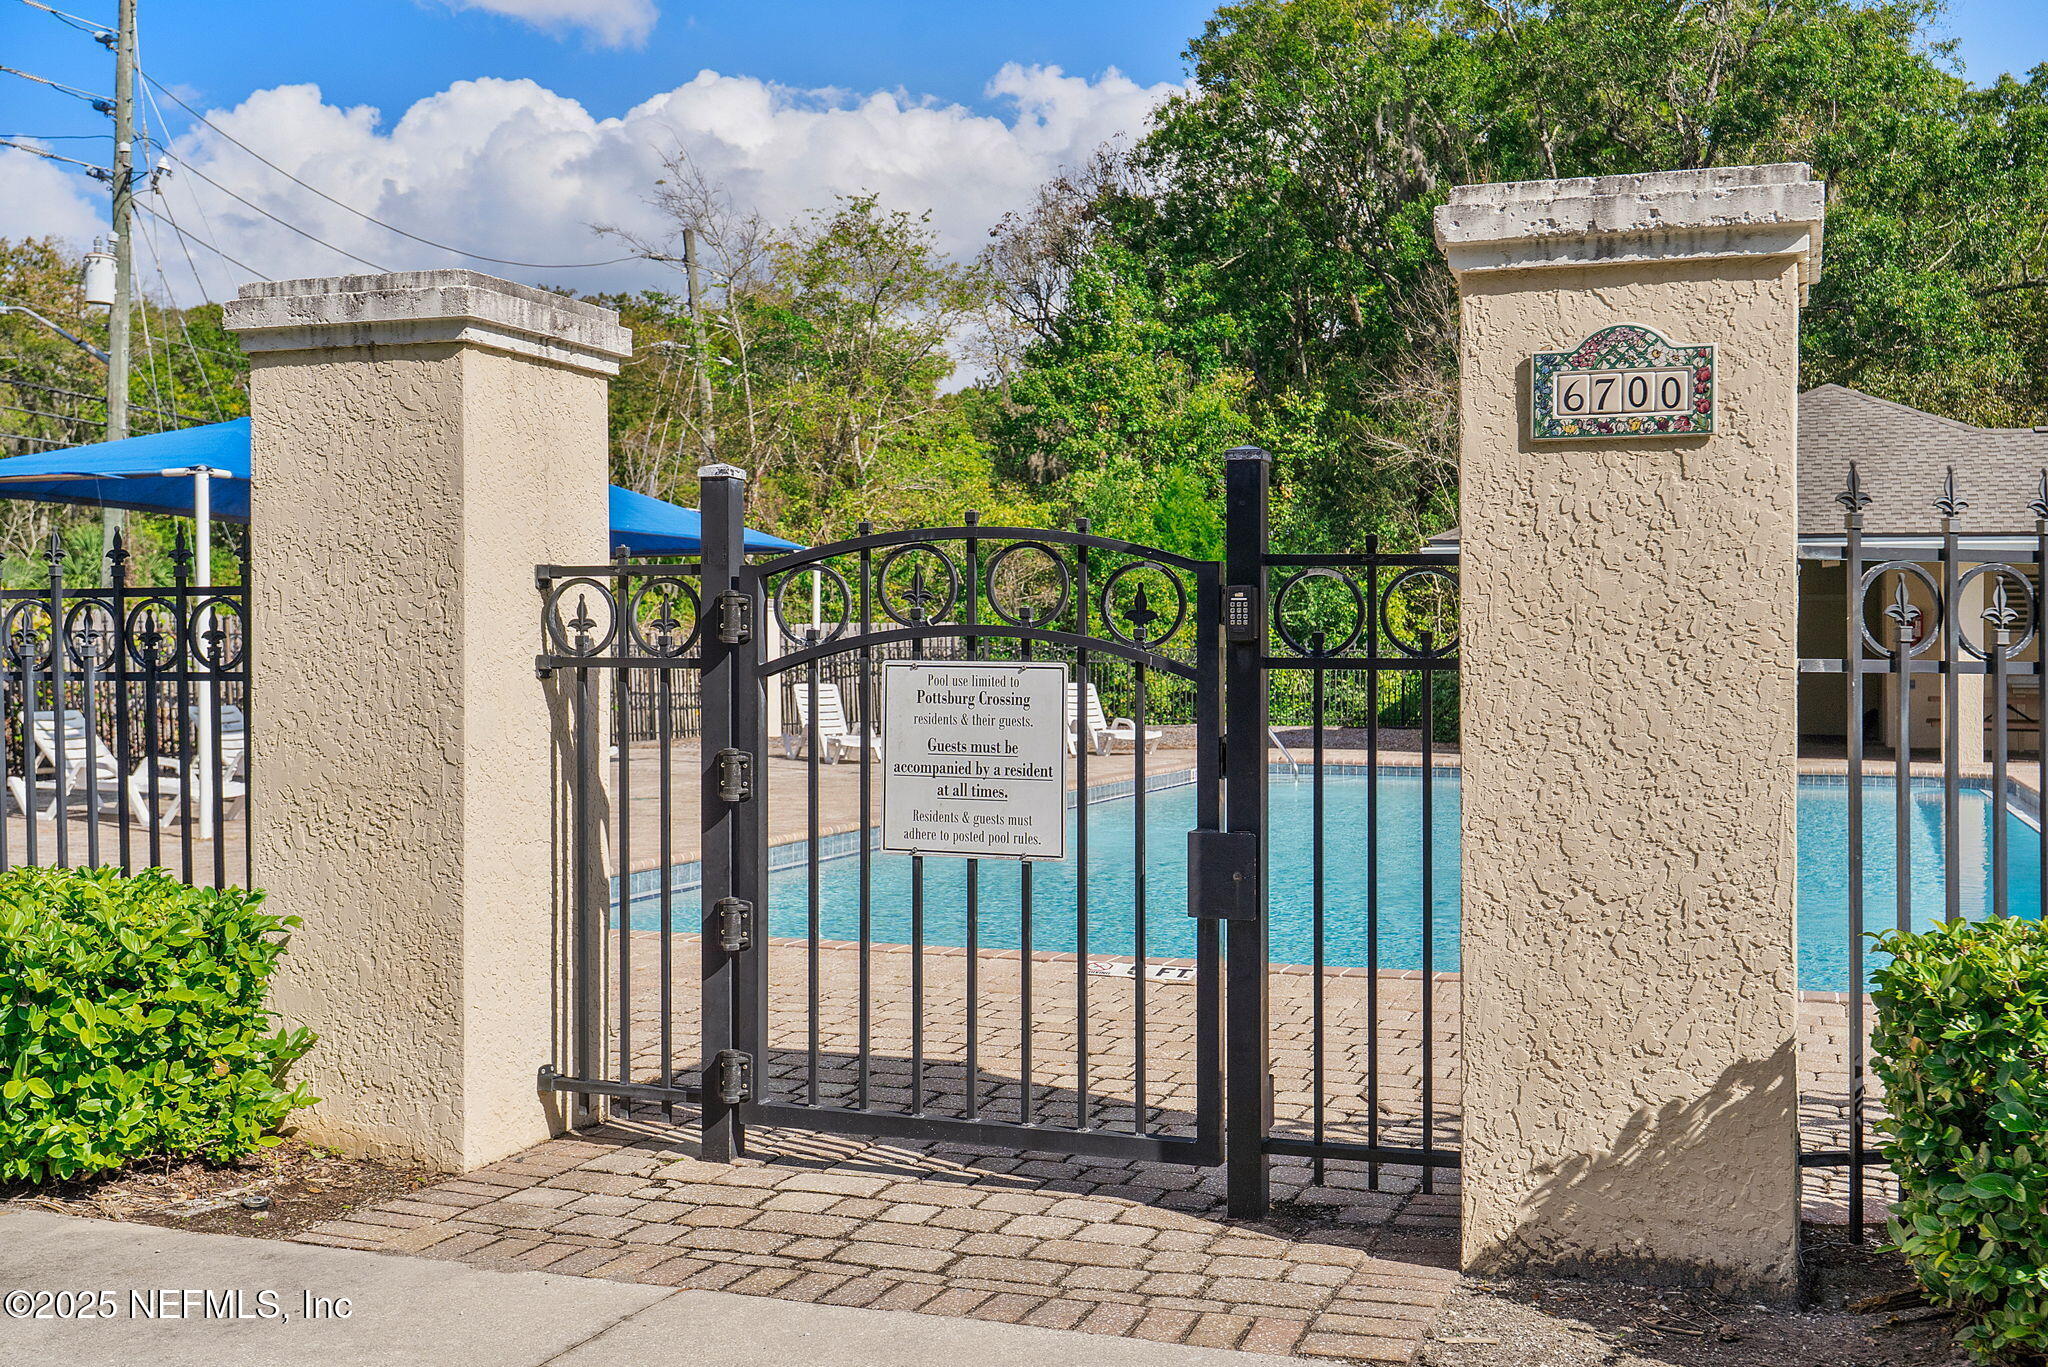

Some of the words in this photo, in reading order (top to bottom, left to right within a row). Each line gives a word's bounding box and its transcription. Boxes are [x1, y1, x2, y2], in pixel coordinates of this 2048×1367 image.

[1563, 376, 1681, 411] 6700
[928, 674, 948, 686] Pool
[953, 676, 968, 686] use
[972, 675, 1006, 687] limited
[1011, 677, 1019, 687] to
[917, 690, 975, 709] Pottsburg
[979, 691, 1031, 711] Crossing
[914, 713, 957, 725] residents
[961, 714, 968, 725] &
[972, 714, 995, 726] their
[999, 716, 1033, 730] guests.
[928, 738, 967, 752] Guests
[971, 741, 1001, 753] must
[1005, 740, 1018, 754] be
[894, 761, 971, 778] accompanied
[976, 762, 989, 780] by
[994, 767, 1000, 775] a
[1005, 763, 1053, 777] resident
[937, 785, 948, 796] at
[953, 784, 967, 796] all
[972, 784, 1008, 798] times.
[913, 810, 959, 823] Residents
[962, 812, 970, 823] &
[973, 813, 1004, 827] guests
[1009, 815, 1032, 826] must
[904, 828, 936, 840] adhere
[940, 830, 949, 841] to
[953, 831, 984, 845] posted
[989, 832, 1009, 846] pool
[1013, 833, 1042, 845] rules.
